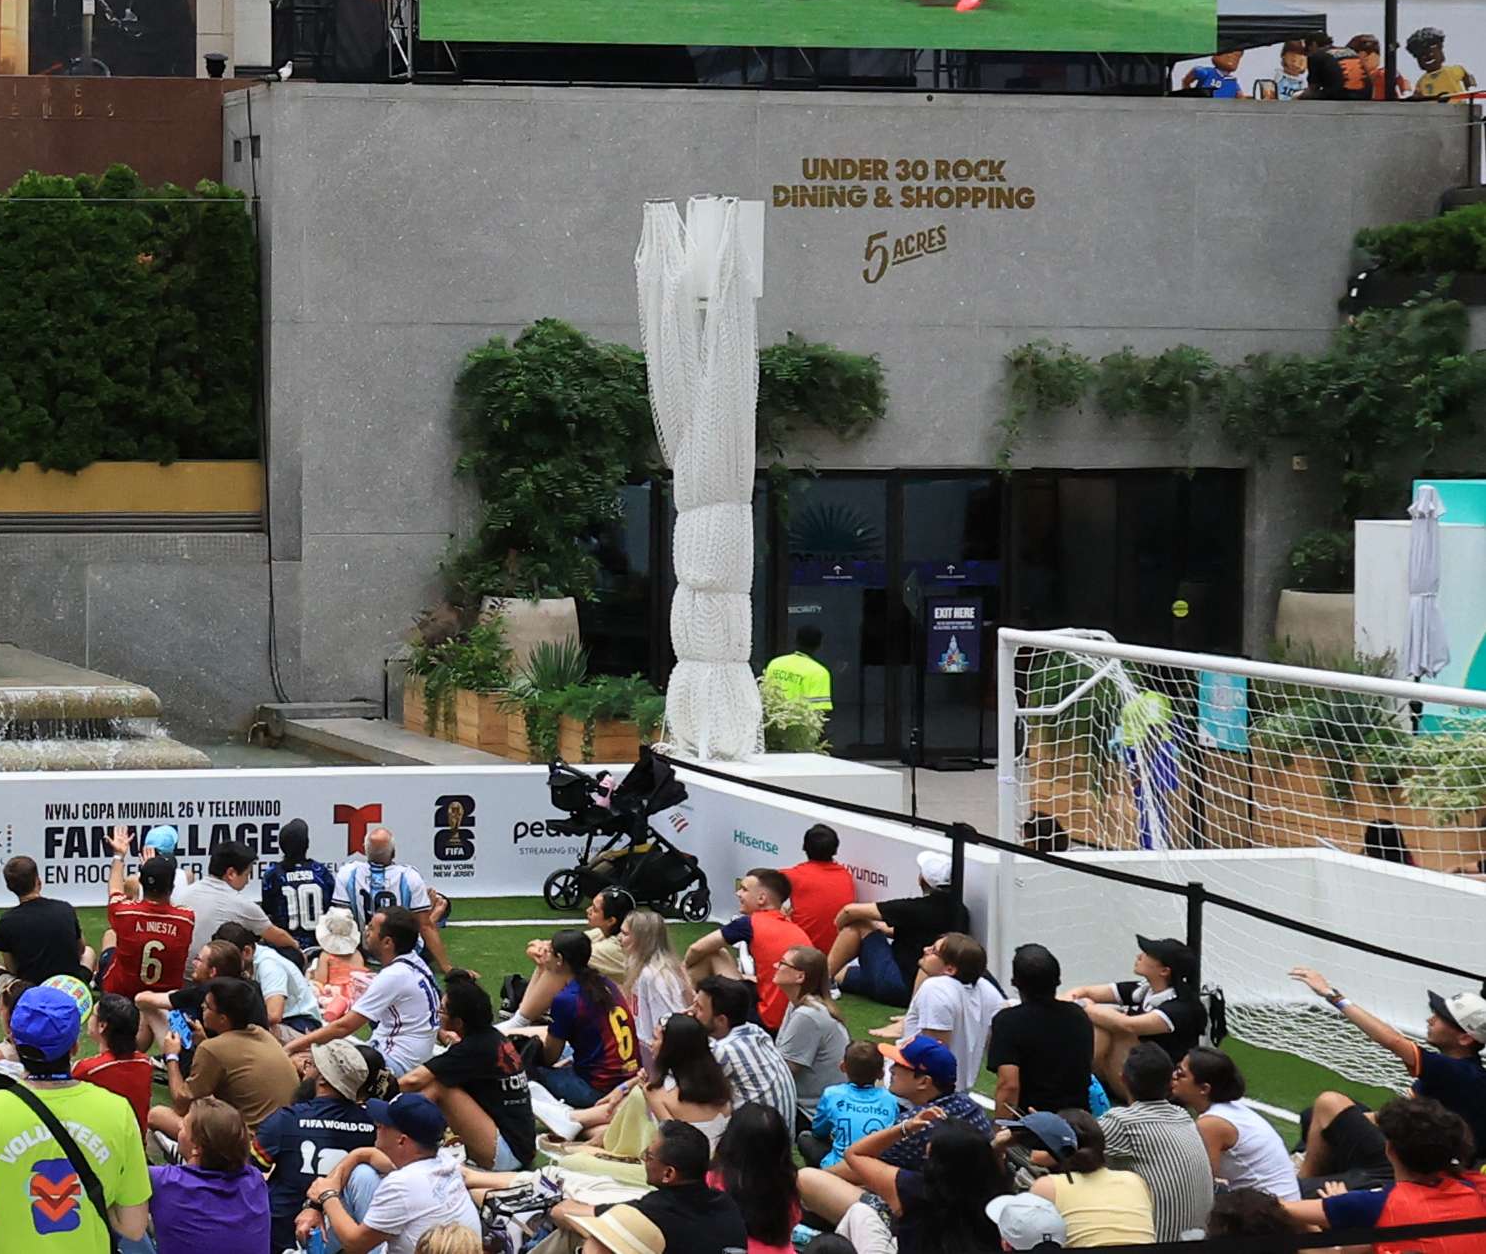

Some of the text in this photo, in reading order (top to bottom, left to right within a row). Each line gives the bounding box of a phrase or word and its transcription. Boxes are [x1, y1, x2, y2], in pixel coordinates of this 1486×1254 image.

[802, 157, 1007, 183] UNDER 30 ROCK
[773, 184, 1035, 210] DINING & SHOPPING
[863, 224, 947, 284] 5 ACRES
[934, 607, 975, 619] EXIT HERE
[45, 799, 281, 821] NYNJ COPA MUNDIAL 26 Y TELEMUNDO
[445, 847, 466, 857] FIFA
[519, 847, 566, 856] STREAMING
[733, 829, 779, 855] Hisense
[45, 866, 67, 884] EN
[286, 871, 314, 883] MESSI
[434, 863, 475, 871] NEW YORK
[281, 884, 325, 929] 10
[146, 922, 177, 936] INIESTA
[140, 940, 165, 984] 6
[608, 1005, 633, 1060] 6
[299, 1118, 375, 1132] FIFA WORLD CUP
